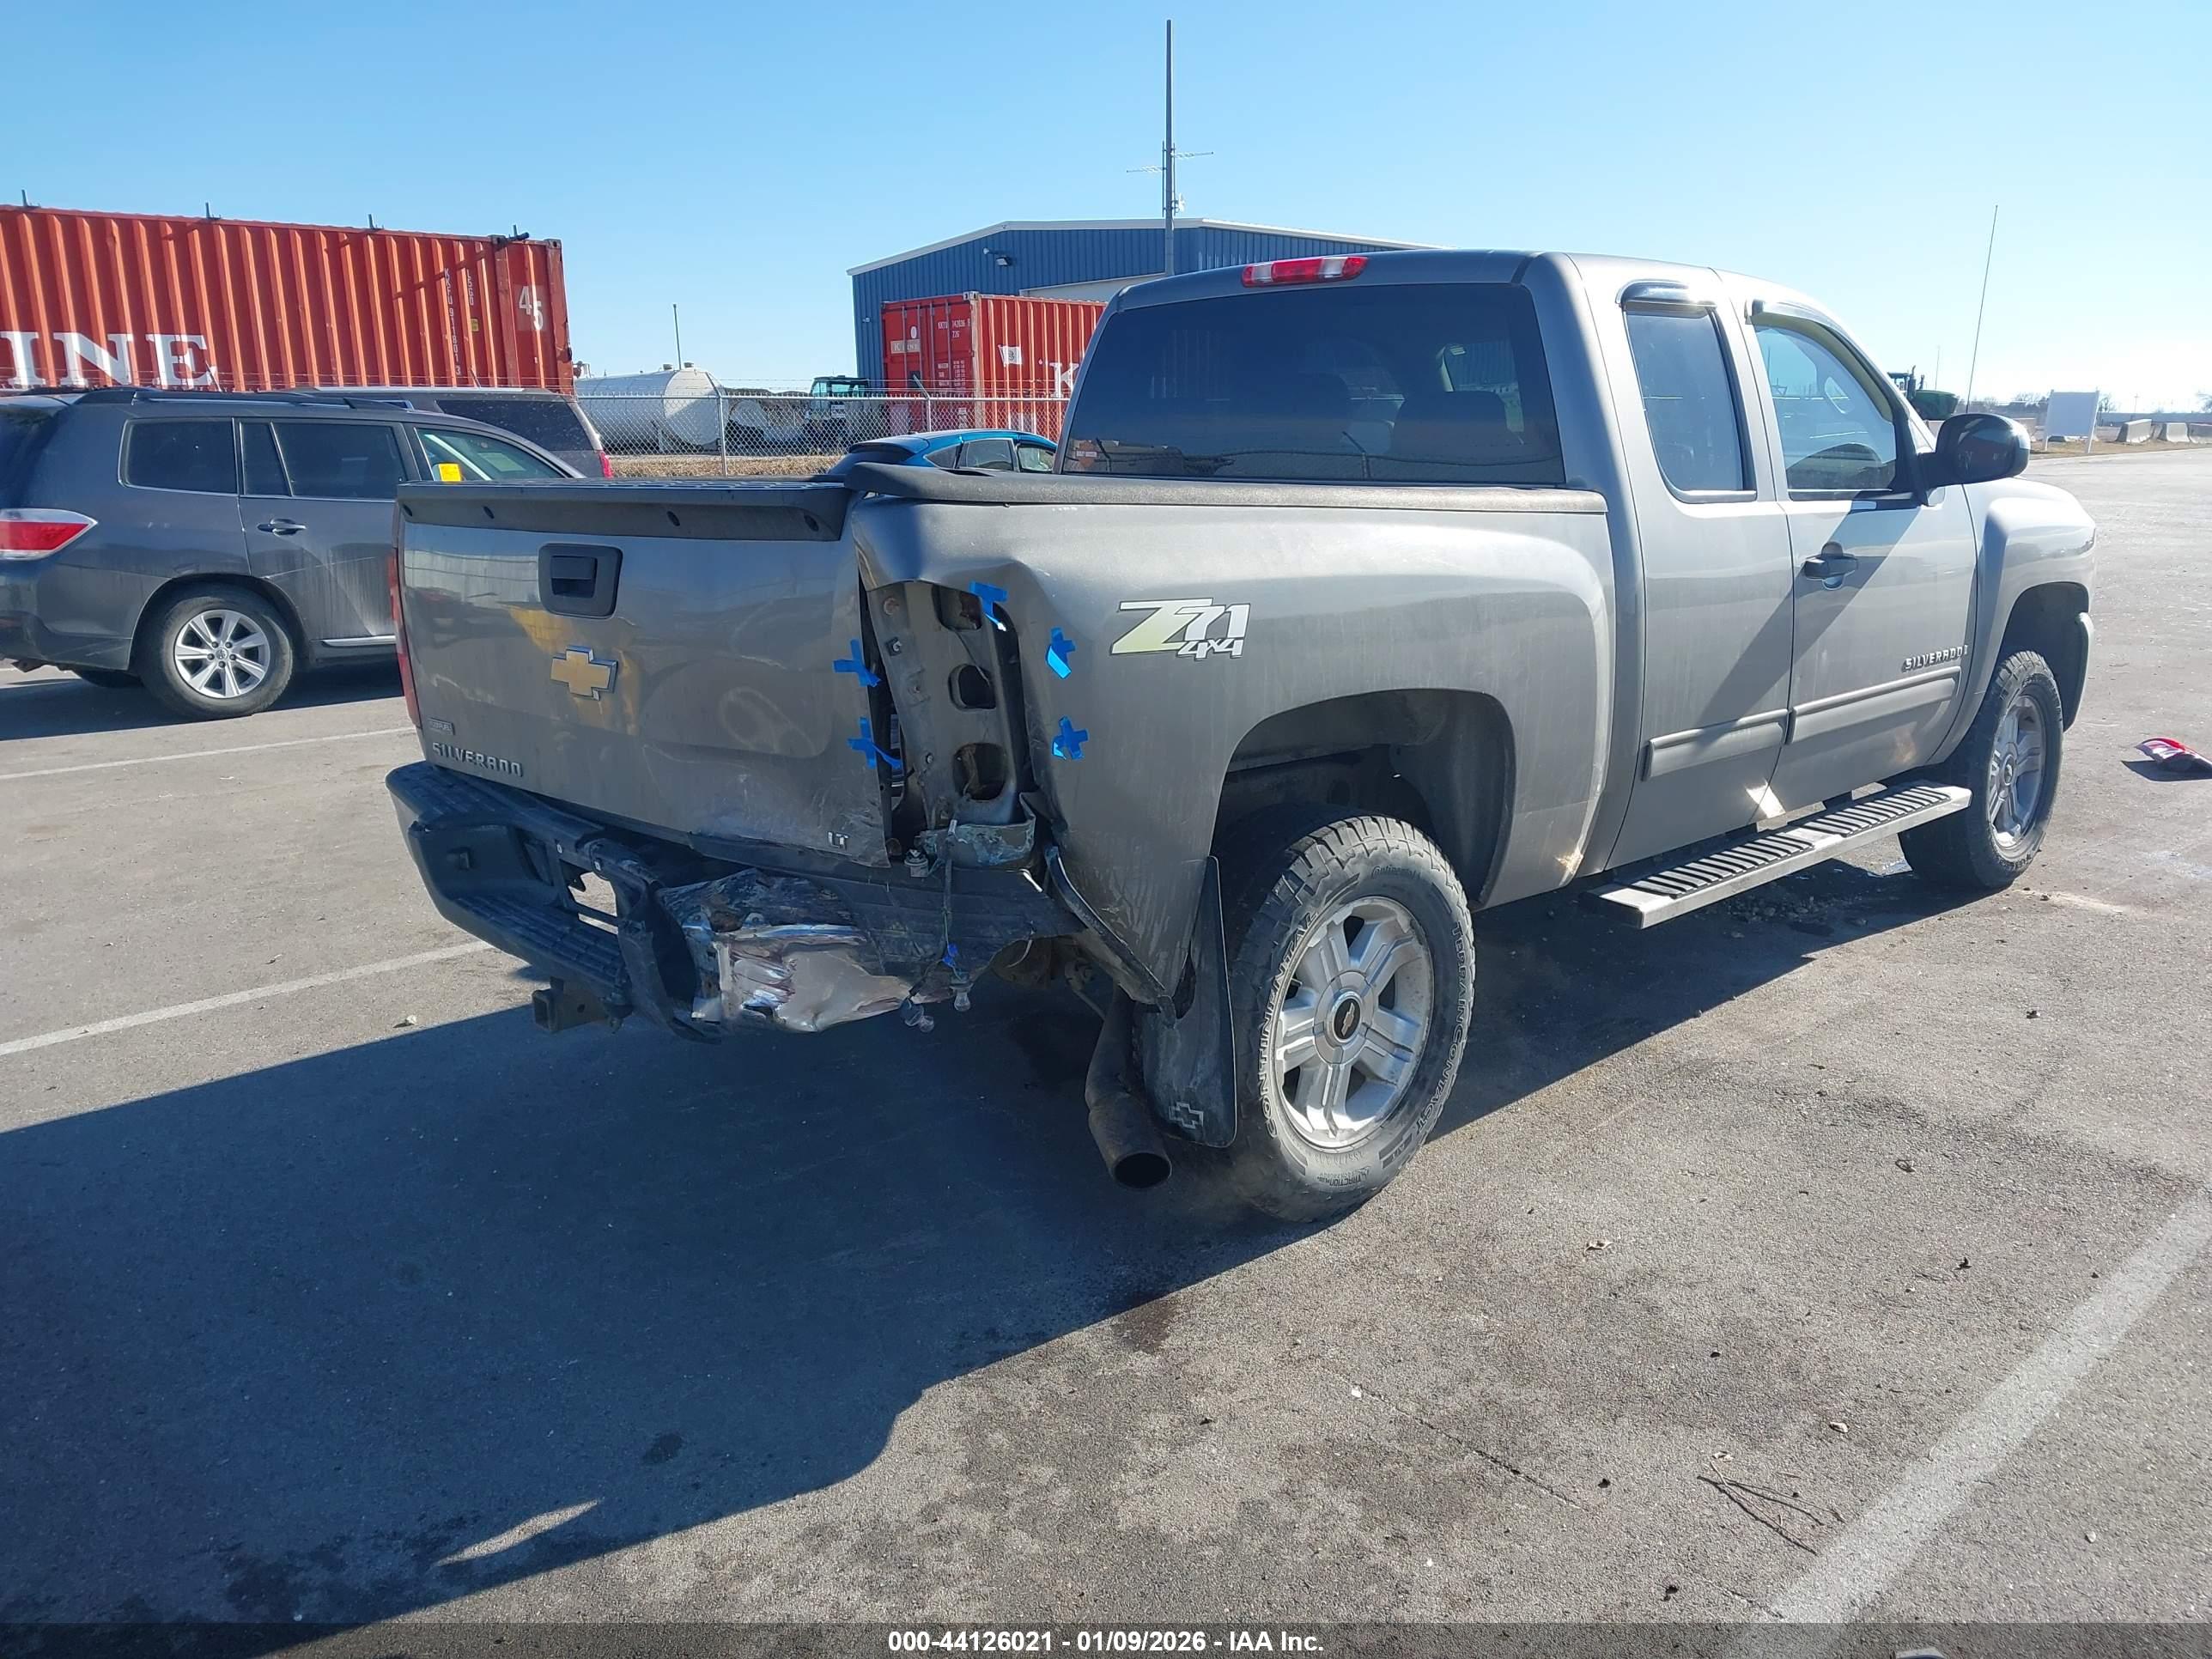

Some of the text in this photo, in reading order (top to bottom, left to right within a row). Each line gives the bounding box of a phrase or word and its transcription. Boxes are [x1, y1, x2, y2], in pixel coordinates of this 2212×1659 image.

[519, 285, 544, 331] 45
[1110, 598, 1251, 656] Z71
[432, 741, 523, 778] SILVERADO
[827, 831, 849, 848] LT
[1257, 911, 1318, 1139] CONTINENTAL
